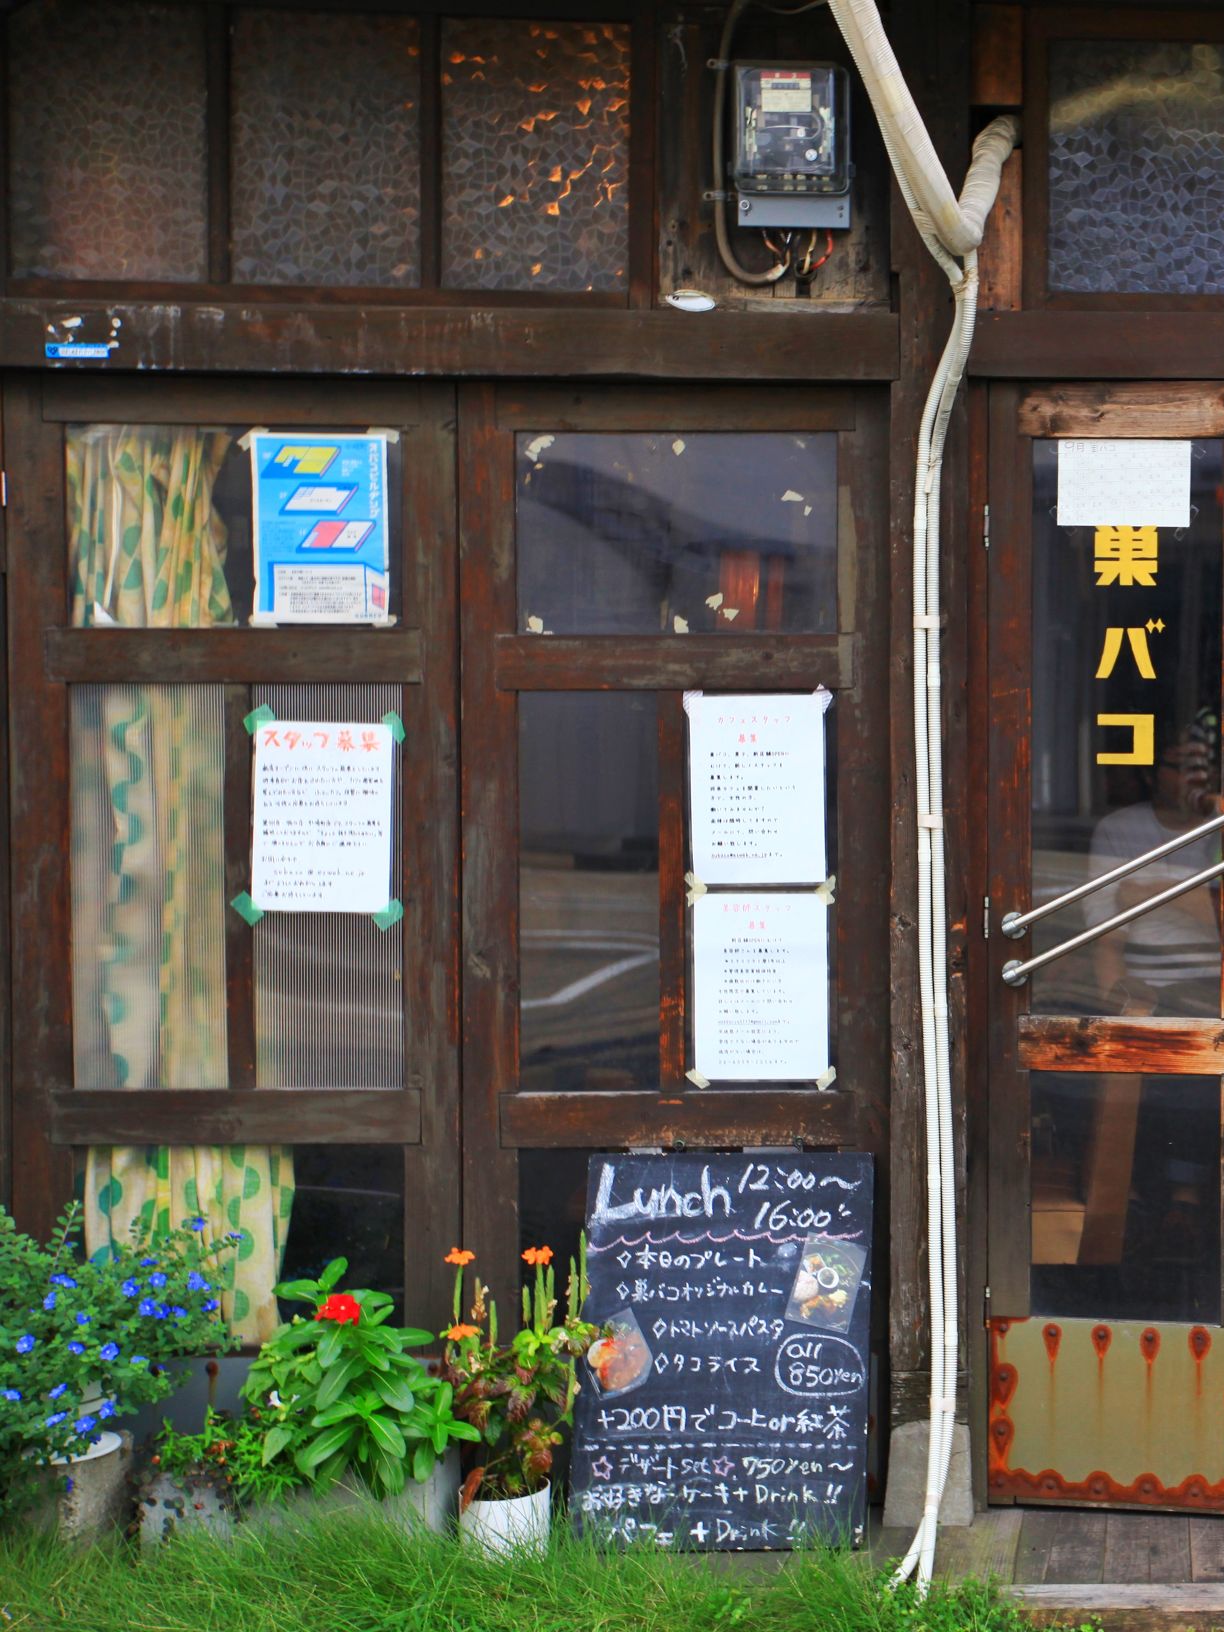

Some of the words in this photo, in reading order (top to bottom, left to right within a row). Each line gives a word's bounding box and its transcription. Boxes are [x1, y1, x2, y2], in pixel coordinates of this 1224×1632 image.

[1094, 526, 1166, 765] 巣バコ
[588, 1162, 736, 1224] Lunch
[754, 1200, 832, 1230] 16:00
[635, 1243, 766, 1270] 本日のプレート
[670, 1315, 784, 1340] トマトソースパスタ
[673, 1353, 761, 1375] タコライス
[786, 1341, 823, 1360] all
